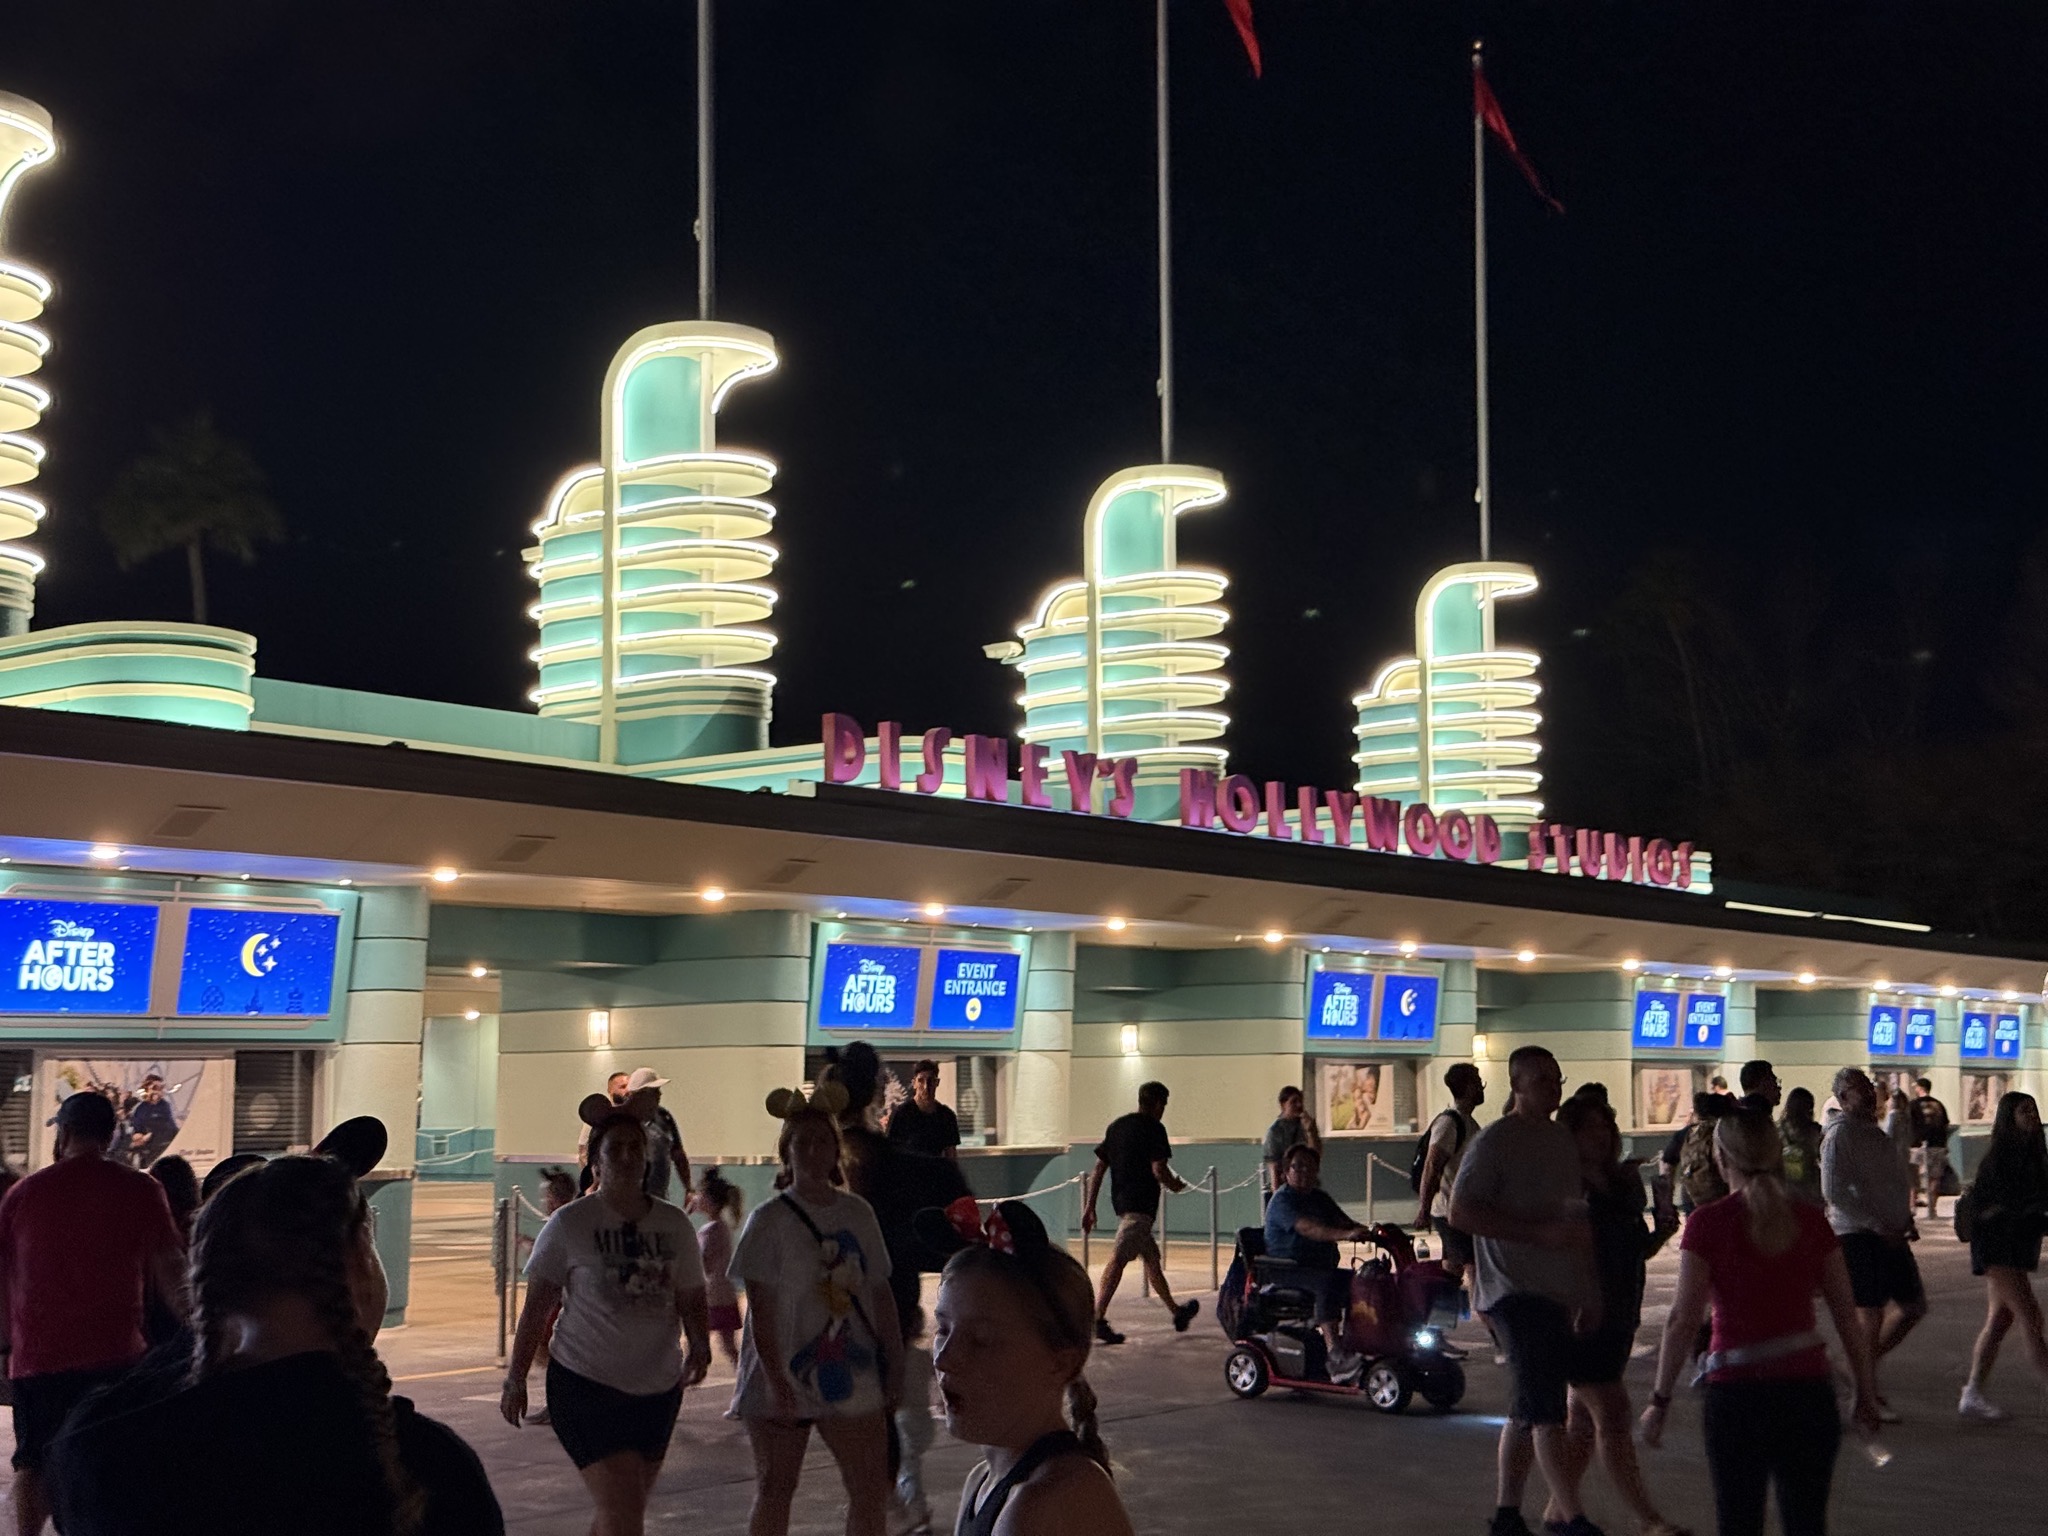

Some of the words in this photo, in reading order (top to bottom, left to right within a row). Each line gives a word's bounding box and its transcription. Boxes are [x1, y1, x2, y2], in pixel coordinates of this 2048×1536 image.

[822, 712, 1138, 818] DISNEY'S
[1179, 767, 1500, 864] HOLLYWOOD
[1527, 819, 1695, 889] STUDIOS
[50, 920, 94, 941] Disney
[23, 940, 116, 967] AFTER
[17, 965, 115, 992] HOURS
[957, 963, 997, 979] EVENT
[844, 975, 895, 994] AFTER
[944, 980, 1006, 996] ENTRANCE
[841, 993, 895, 1013] HOURS
[1324, 995, 1359, 1010] AFTER
[1322, 1009, 1358, 1026] HOURS
